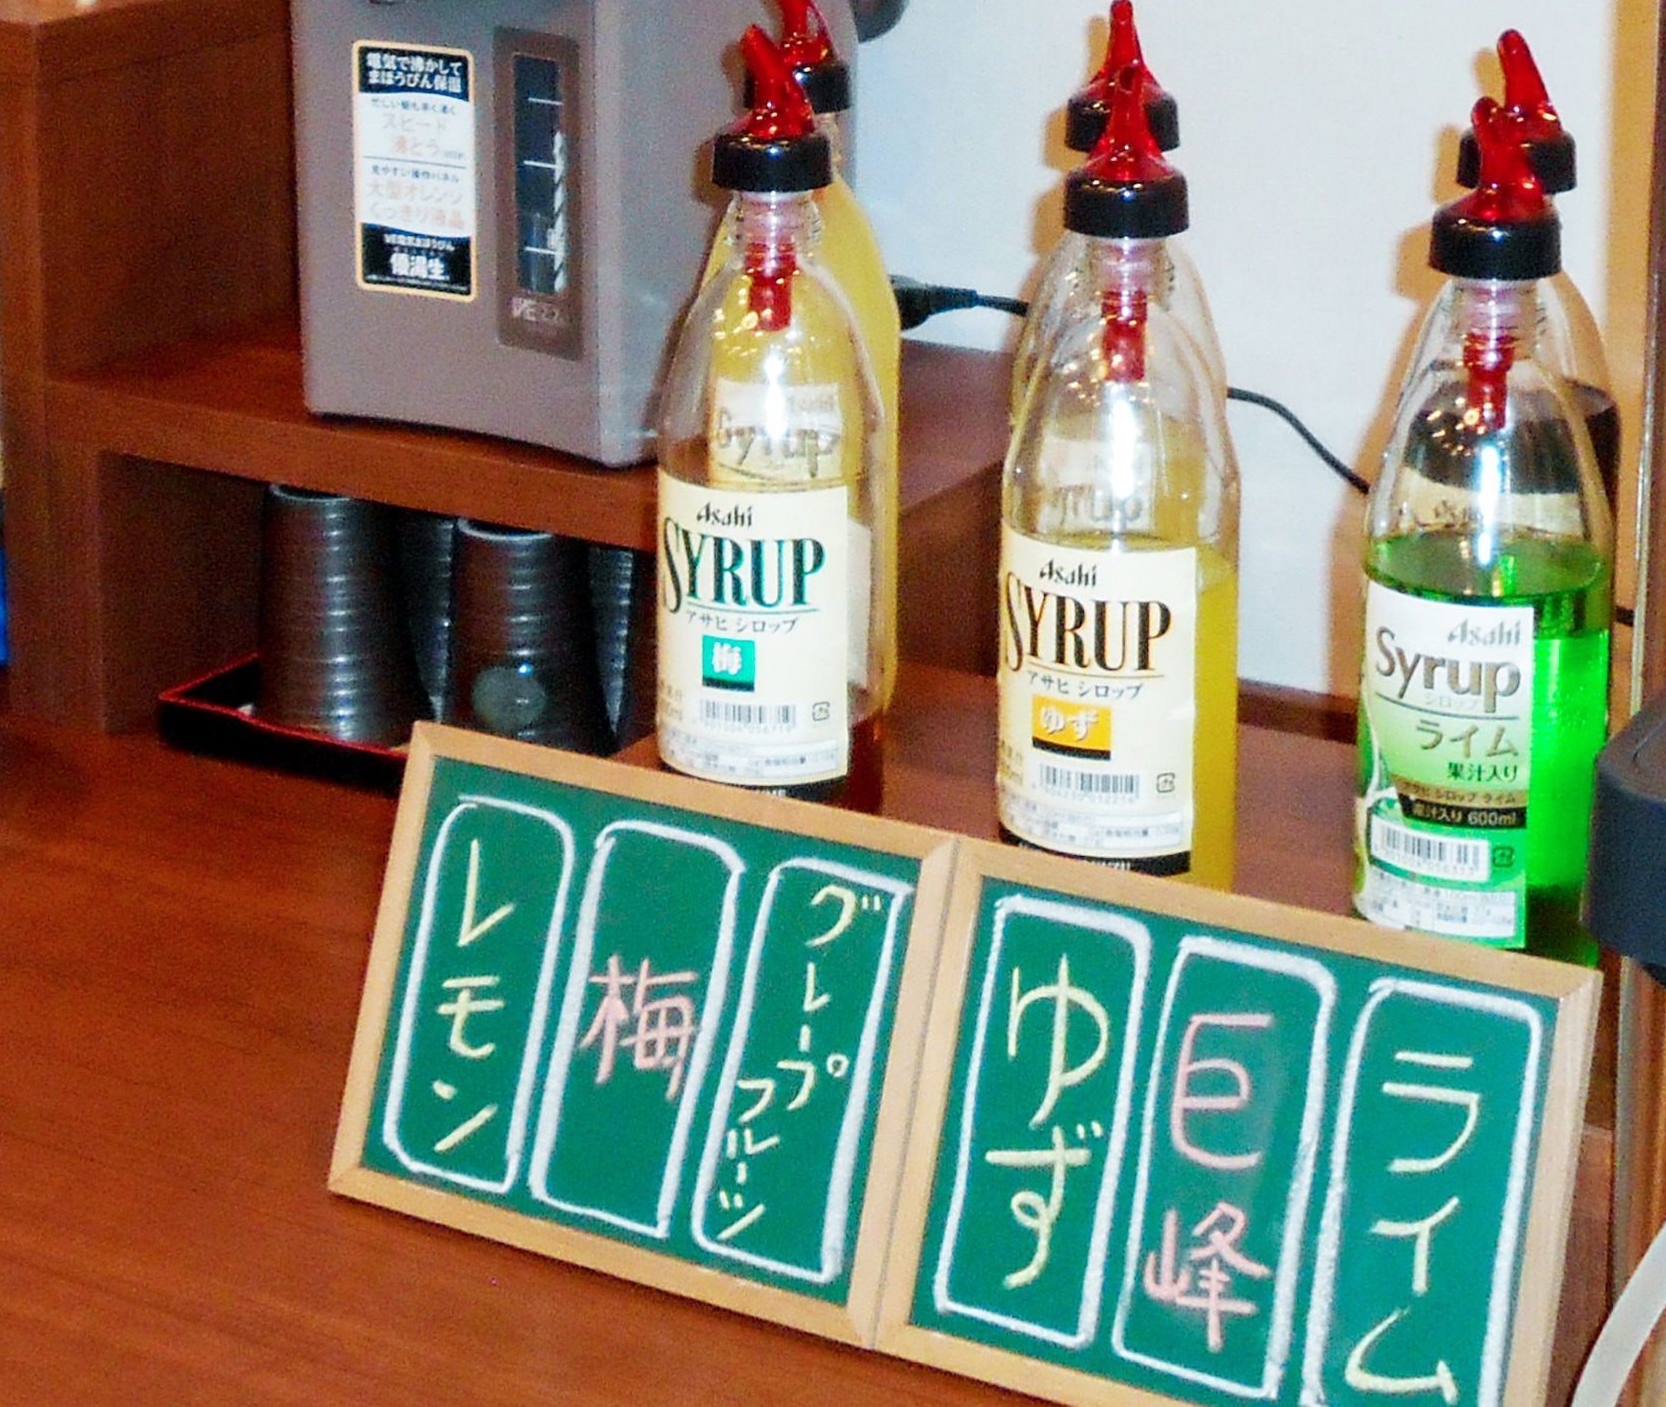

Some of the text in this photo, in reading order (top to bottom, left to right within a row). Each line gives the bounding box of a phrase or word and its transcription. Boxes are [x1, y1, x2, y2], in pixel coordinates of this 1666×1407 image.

[696, 499, 753, 528] Asahi
[661, 516, 827, 614] SYRUP
[1038, 557, 1099, 588] Asahi
[685, 610, 800, 634] アサヒ シロップ
[1004, 570, 1172, 674] SYRUP
[1447, 617, 1522, 647] Asahi
[1027, 670, 1143, 702] アサヒ シロップ
[1375, 626, 1522, 714] Syrup
[1040, 705, 1099, 742] ゆず
[1416, 719, 1520, 759] ライム
[1447, 760, 1519, 784] 果汁入り
[1467, 811, 1518, 826] 600ml
[432, 838, 516, 1156] レモン
[579, 954, 706, 1105] 梅
[985, 953, 1110, 1290] ゆず
[1143, 1011, 1277, 1356] 巨峰
[1342, 1051, 1482, 1405] ライム
